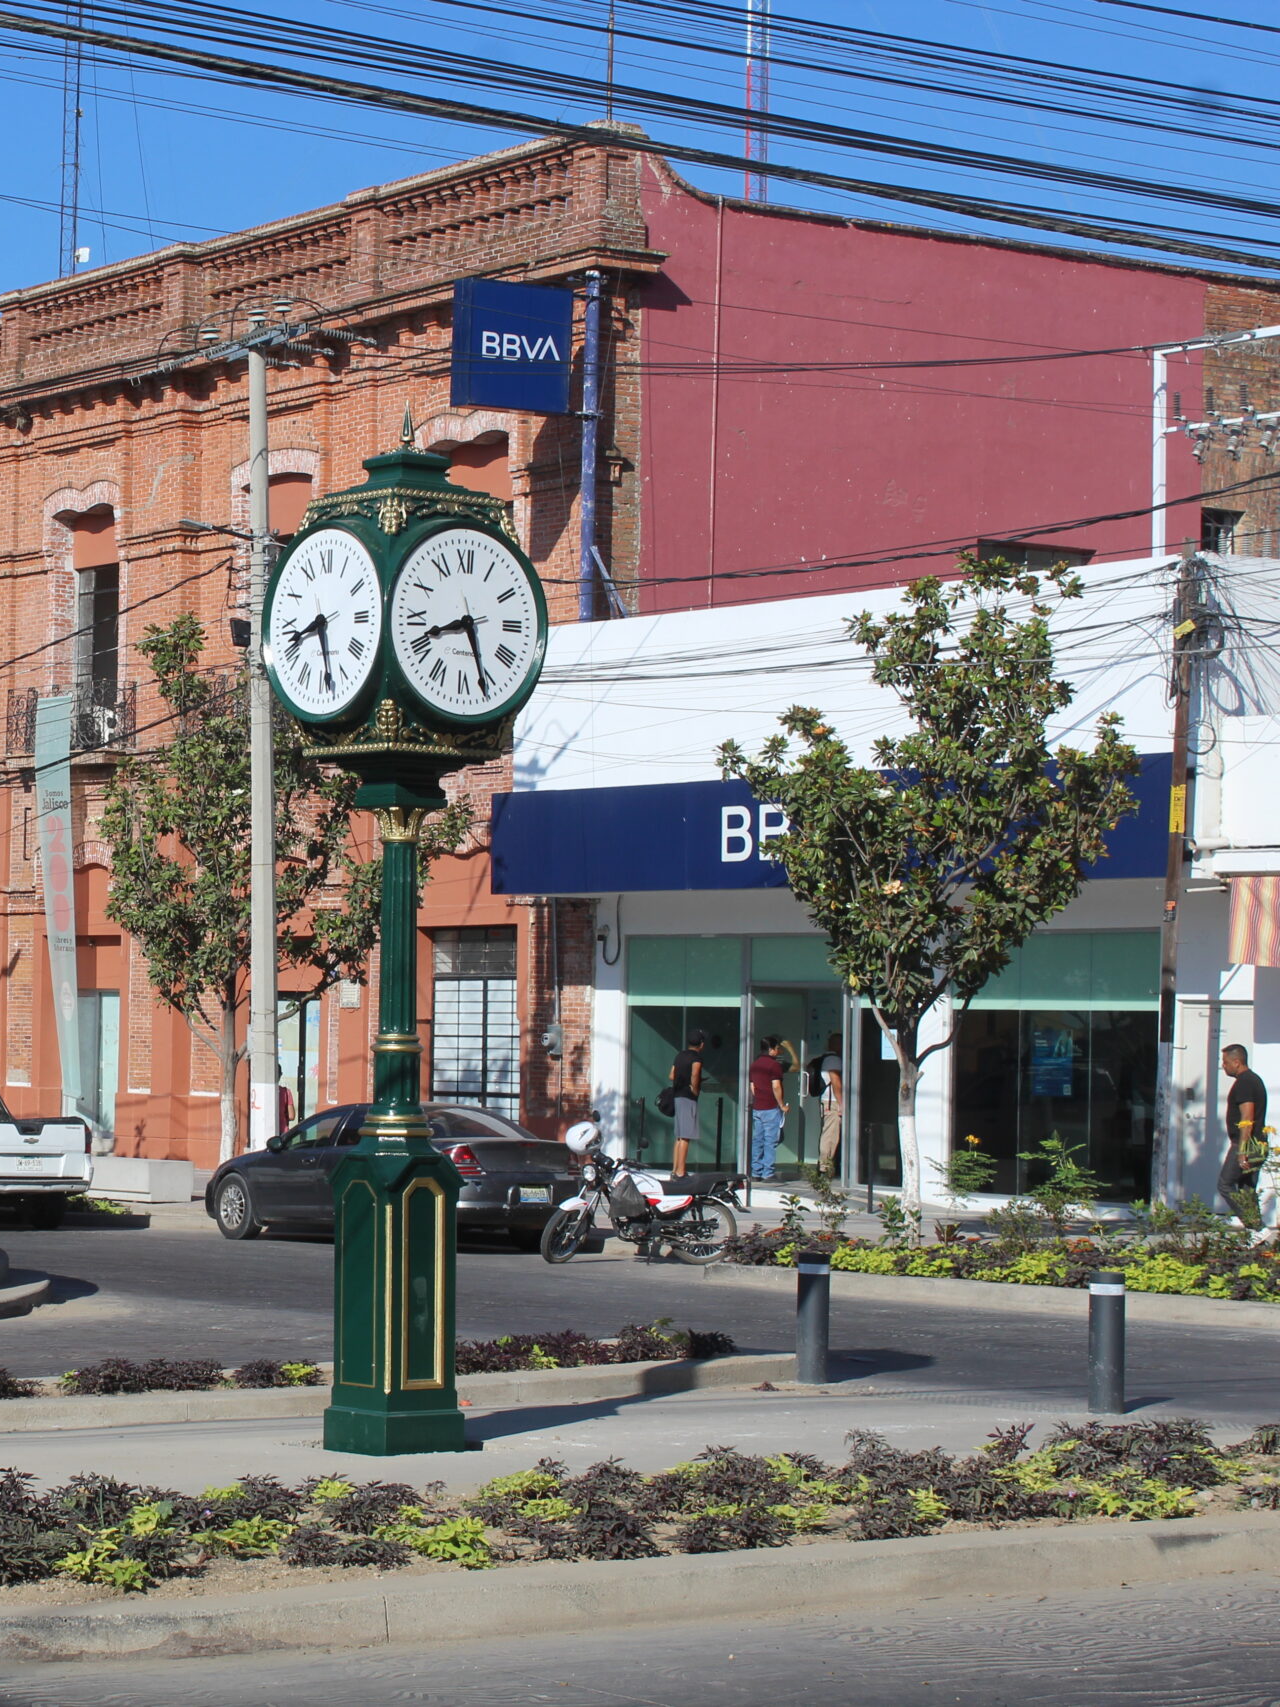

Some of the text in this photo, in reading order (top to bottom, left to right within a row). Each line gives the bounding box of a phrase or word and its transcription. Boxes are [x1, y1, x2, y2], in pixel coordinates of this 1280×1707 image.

[482, 330, 560, 362] BBVA
[45, 789, 64, 797] Somos
[42, 798, 69, 810] Jalisco
